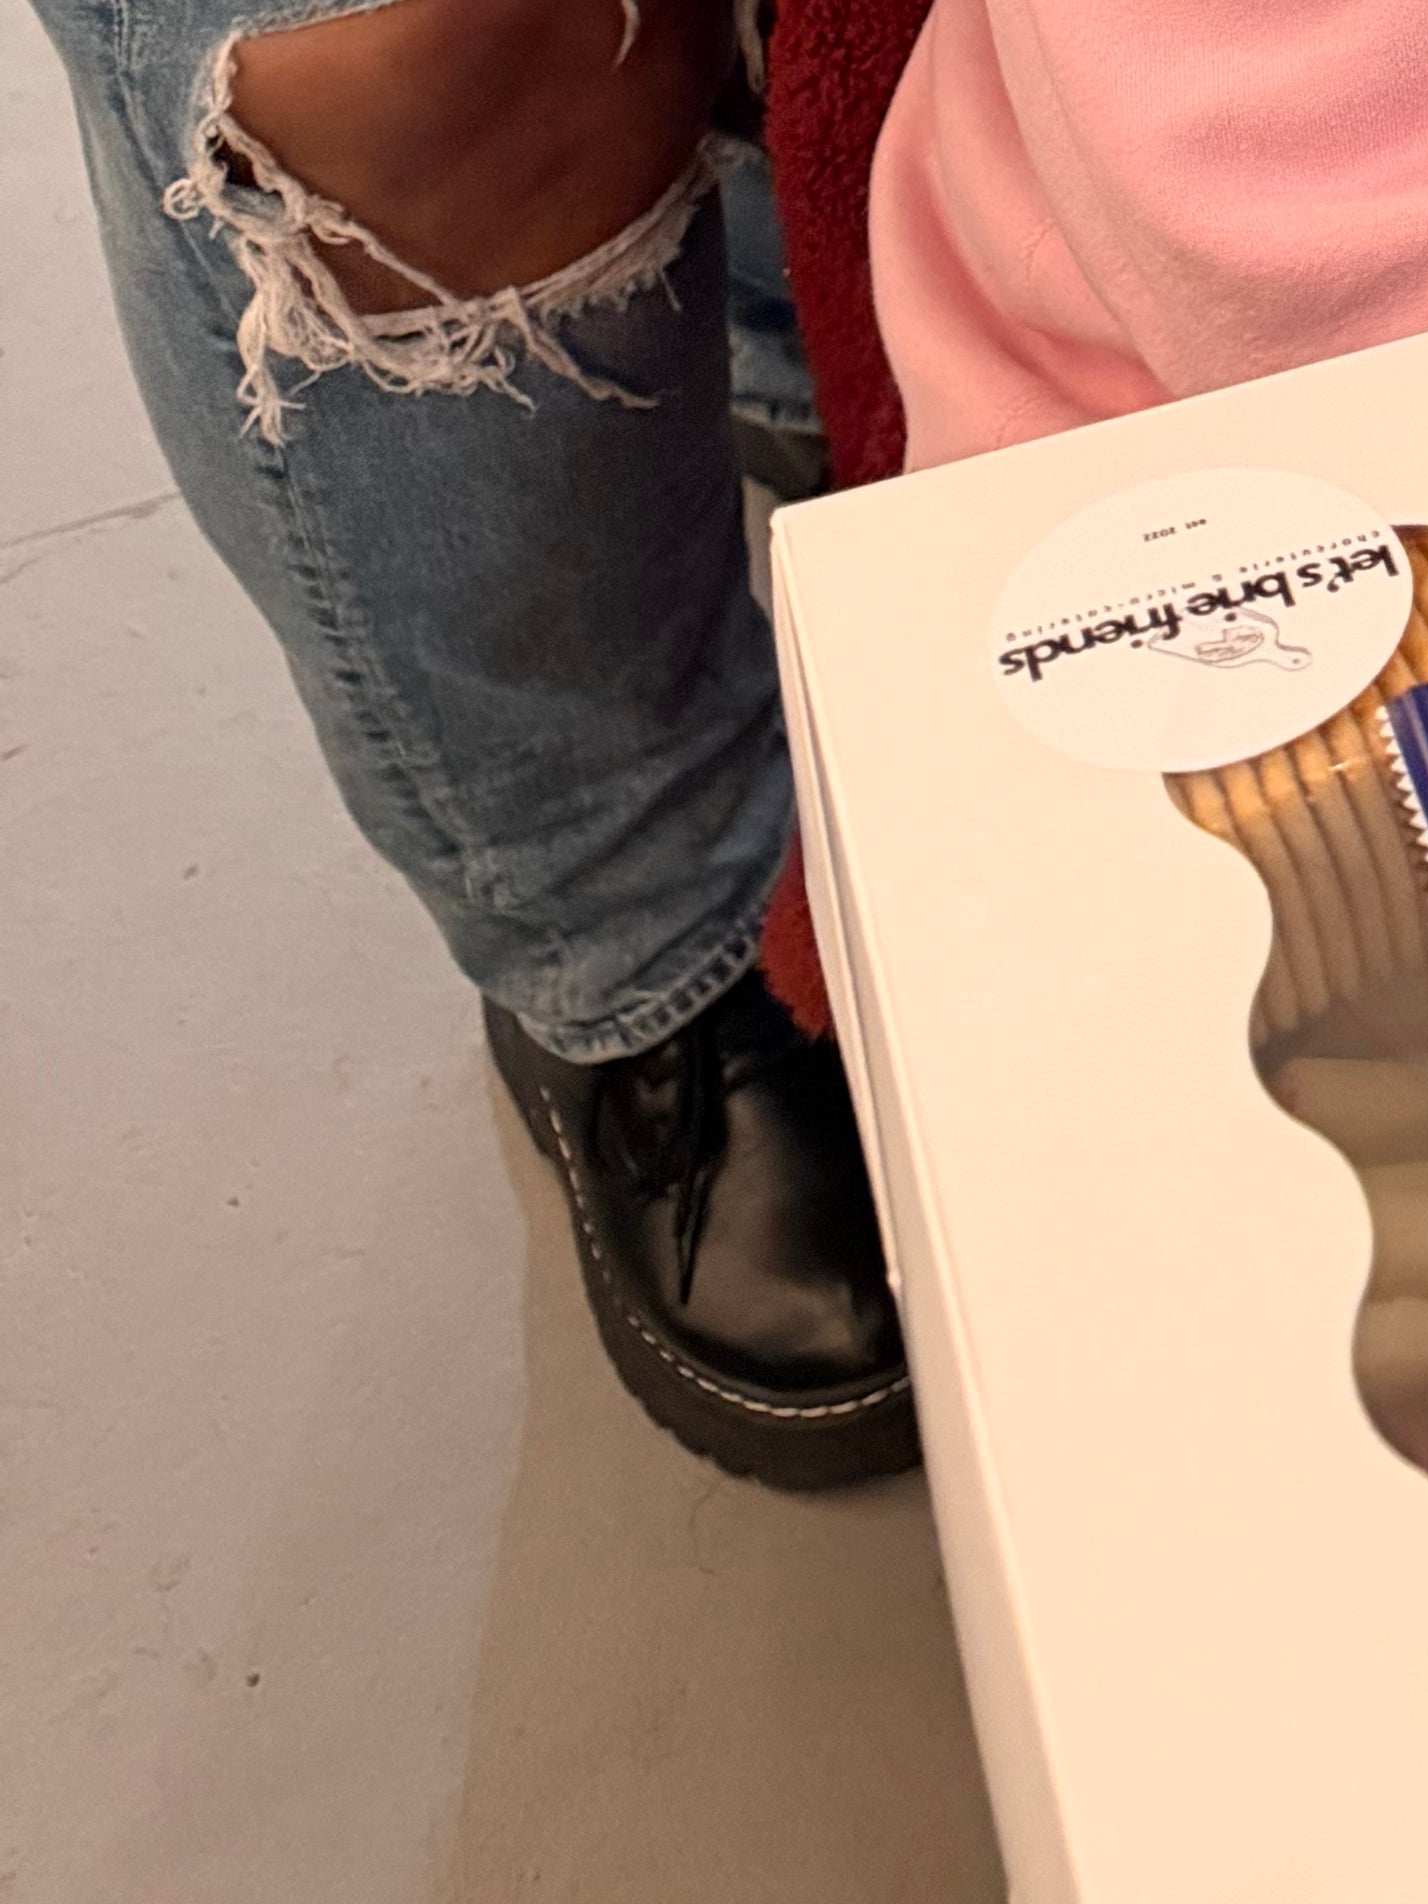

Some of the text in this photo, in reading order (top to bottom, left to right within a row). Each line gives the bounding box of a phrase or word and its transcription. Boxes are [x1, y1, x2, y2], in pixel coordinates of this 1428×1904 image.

[1143, 526, 1176, 542] 2022
[998, 544, 1400, 682] let's brie friends
